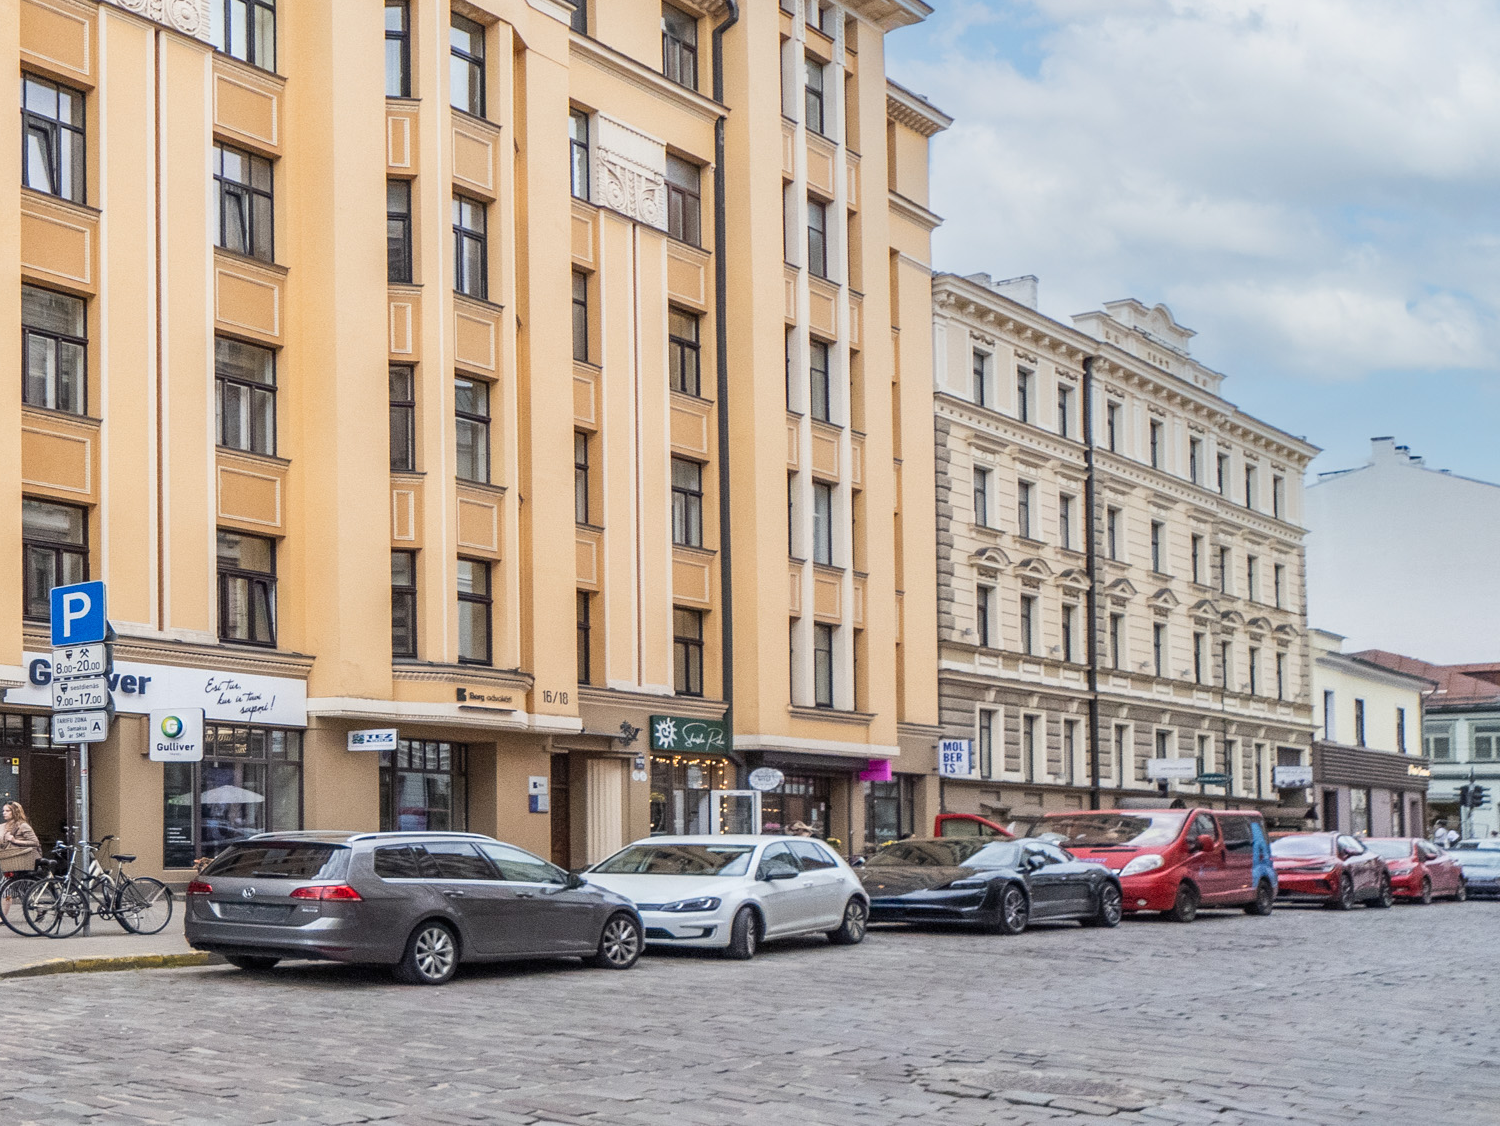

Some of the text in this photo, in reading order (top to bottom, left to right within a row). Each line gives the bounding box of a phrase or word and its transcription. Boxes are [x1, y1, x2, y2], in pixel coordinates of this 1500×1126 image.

[63, 592, 92, 637] P
[29, 658, 152, 695] Gver
[542, 690, 569, 705] 16/18
[92, 721, 102, 731] A
[156, 742, 195, 752] Gulliver
[943, 741, 965, 751] MOL
[943, 752, 963, 762] BER
[943, 763, 956, 774] TS
